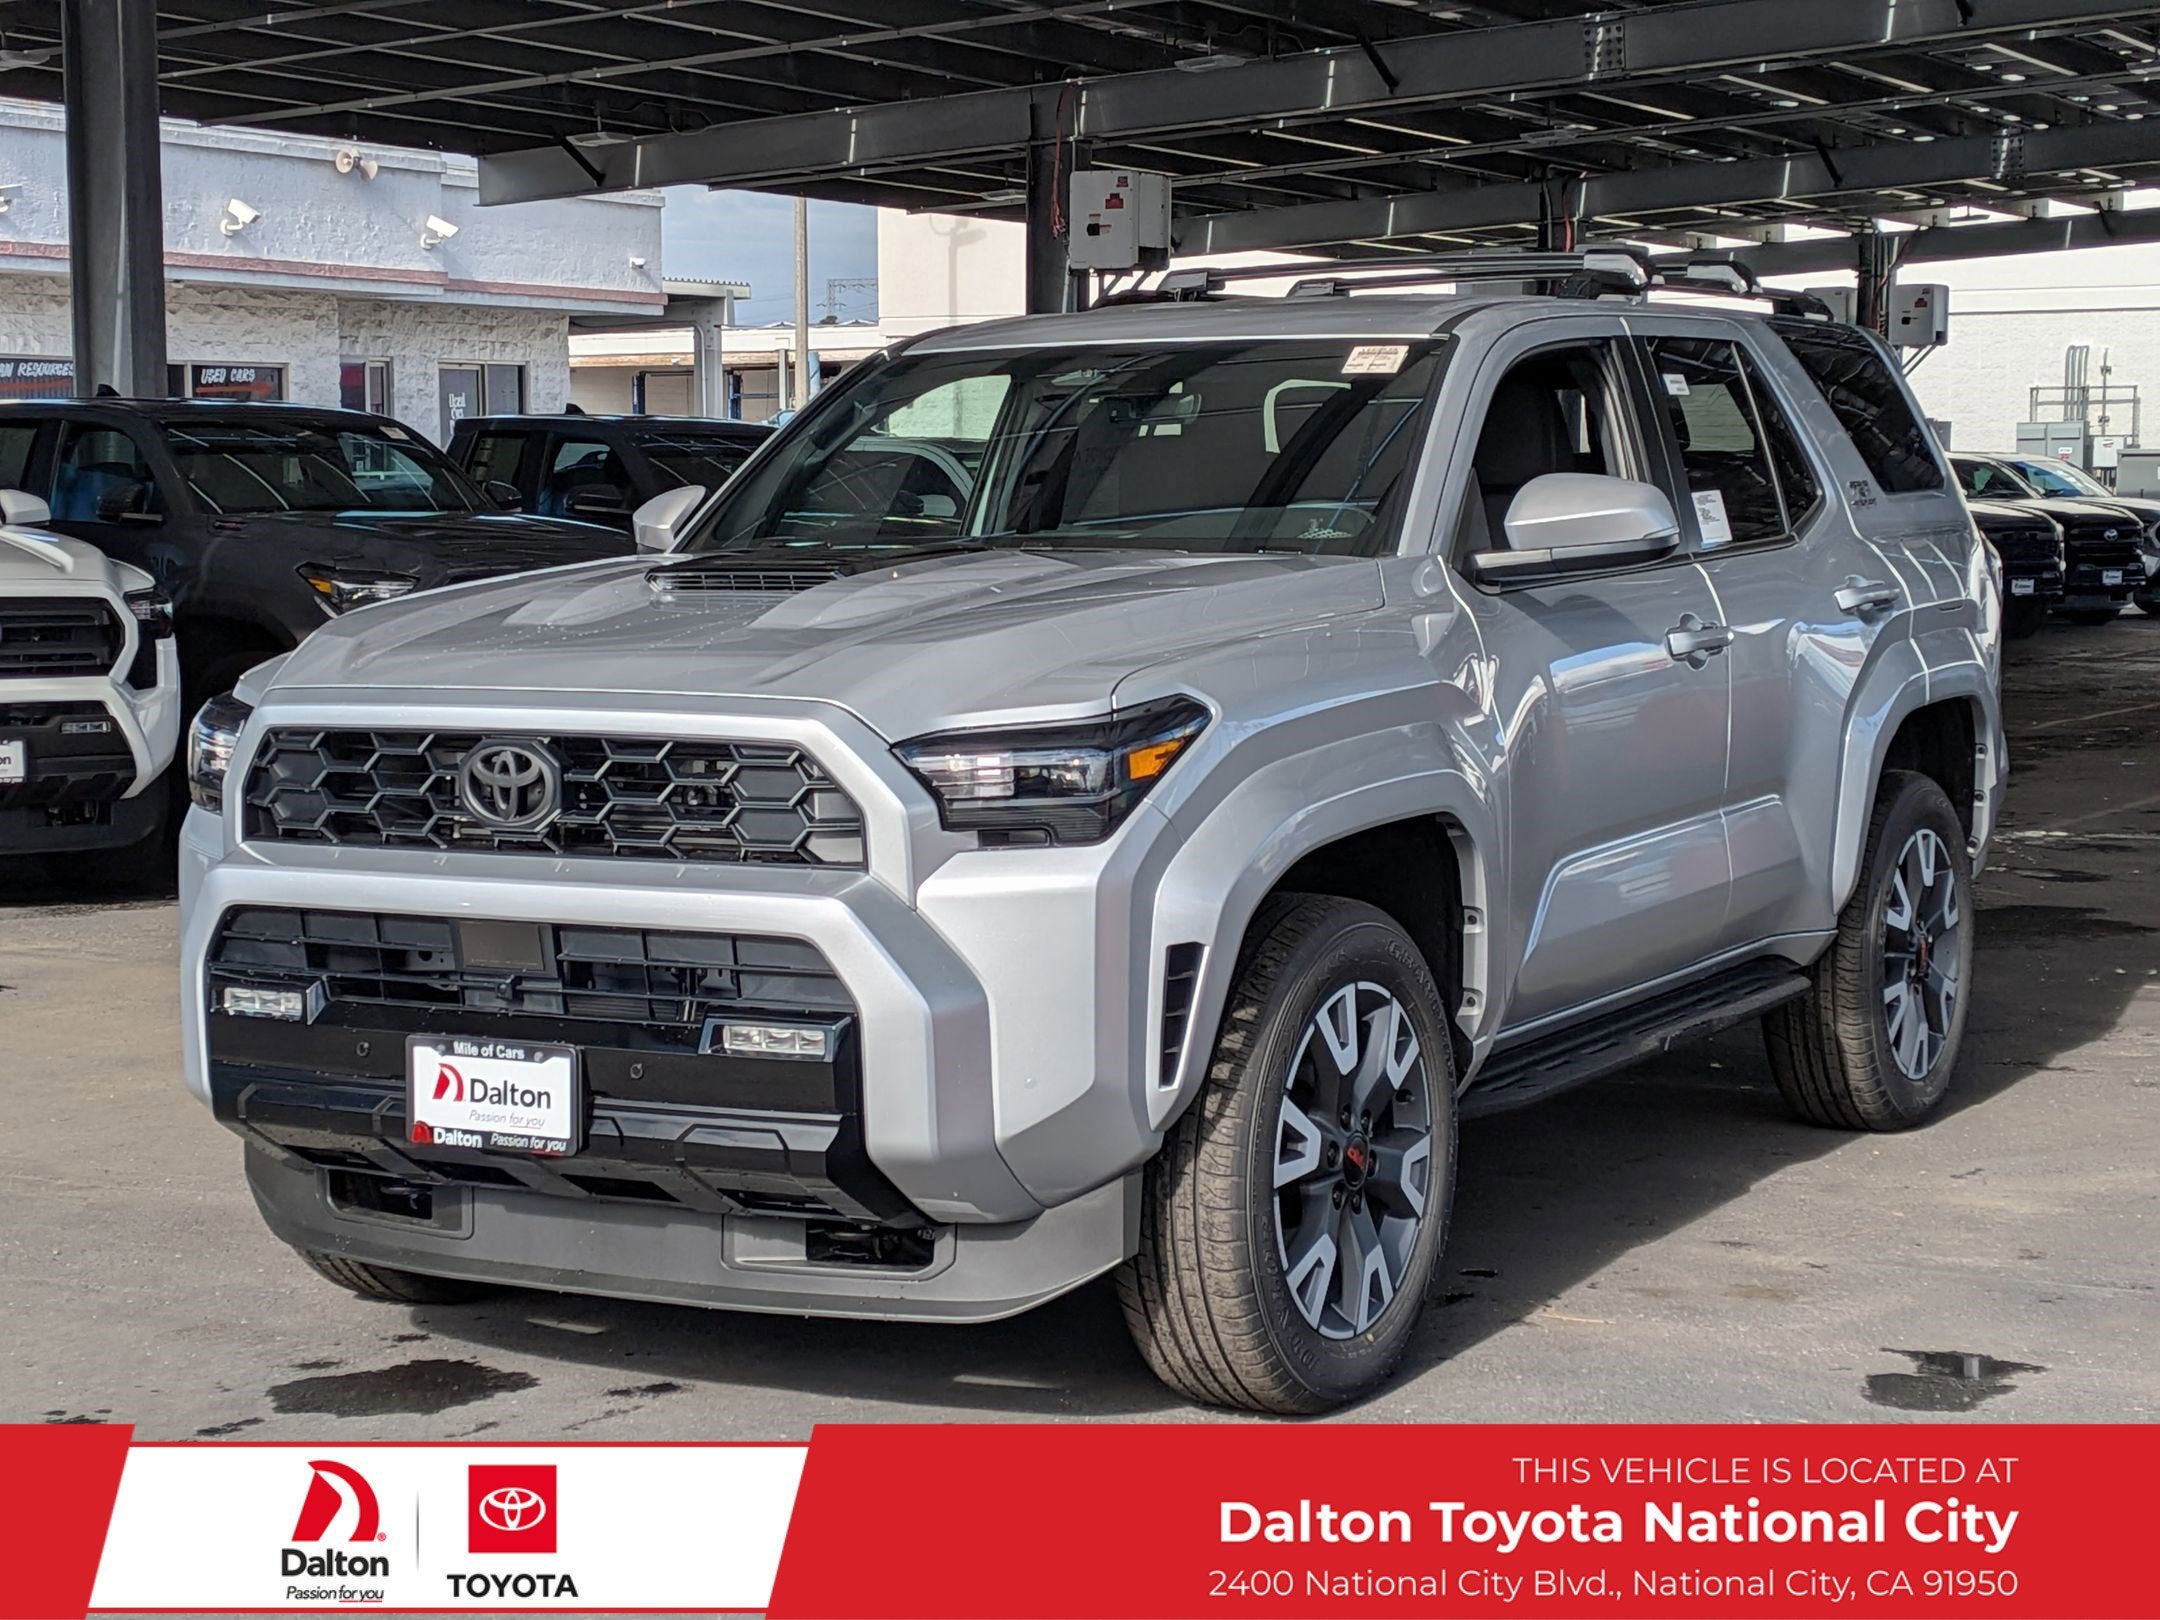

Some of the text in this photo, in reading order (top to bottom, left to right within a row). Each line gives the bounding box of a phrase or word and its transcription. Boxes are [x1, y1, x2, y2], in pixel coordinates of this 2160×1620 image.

[201, 367, 256, 384] USED CARS
[453, 1040, 525, 1060] Mile of Cars
[470, 1078, 552, 1109] Dalton
[469, 1109, 546, 1128] Passion for you
[433, 1127, 483, 1149] Dalton
[490, 1132, 567, 1152] Passion for you
